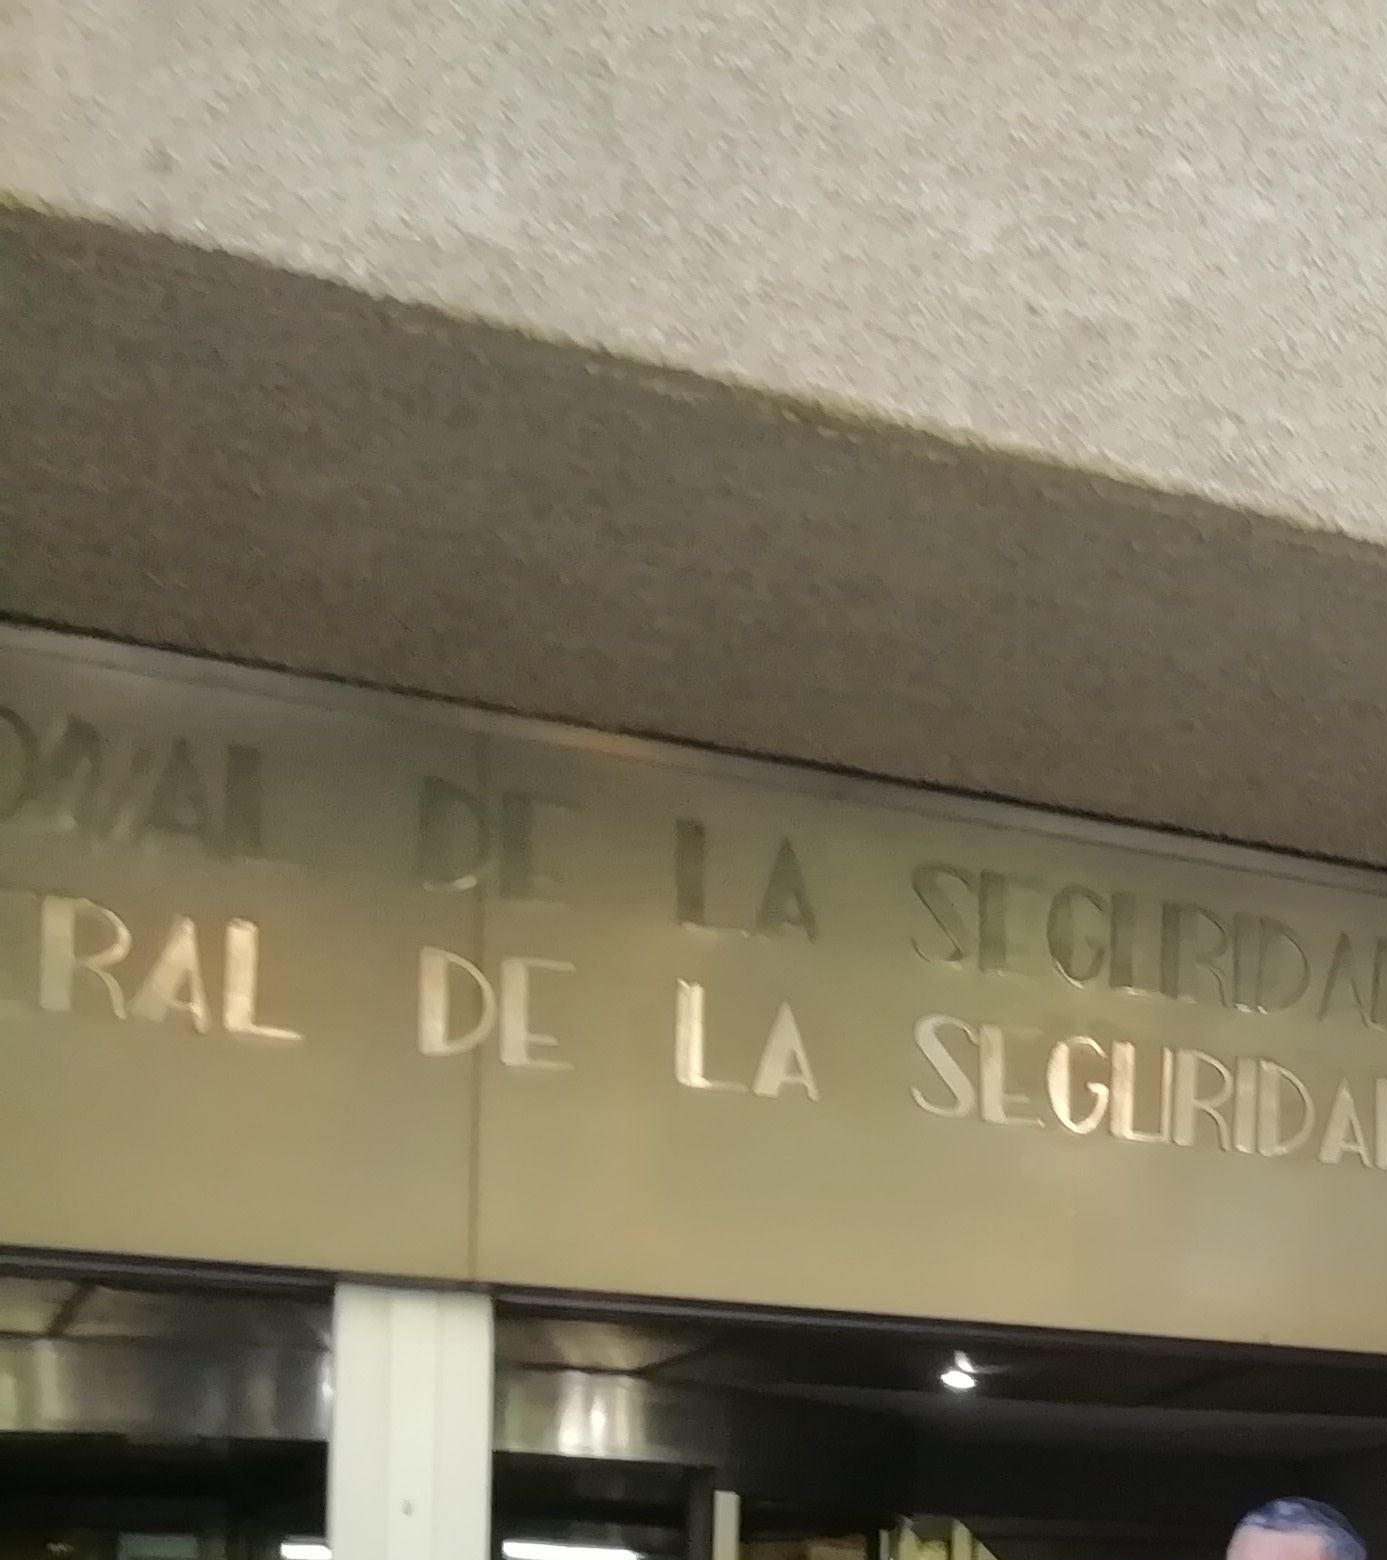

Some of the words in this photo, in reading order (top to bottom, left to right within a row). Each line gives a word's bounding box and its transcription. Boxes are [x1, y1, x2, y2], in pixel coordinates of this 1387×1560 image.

[415, 774, 580, 912] DE
[674, 818, 818, 944] LA
[418, 945, 576, 1070] DE
[675, 977, 818, 1101] LA
